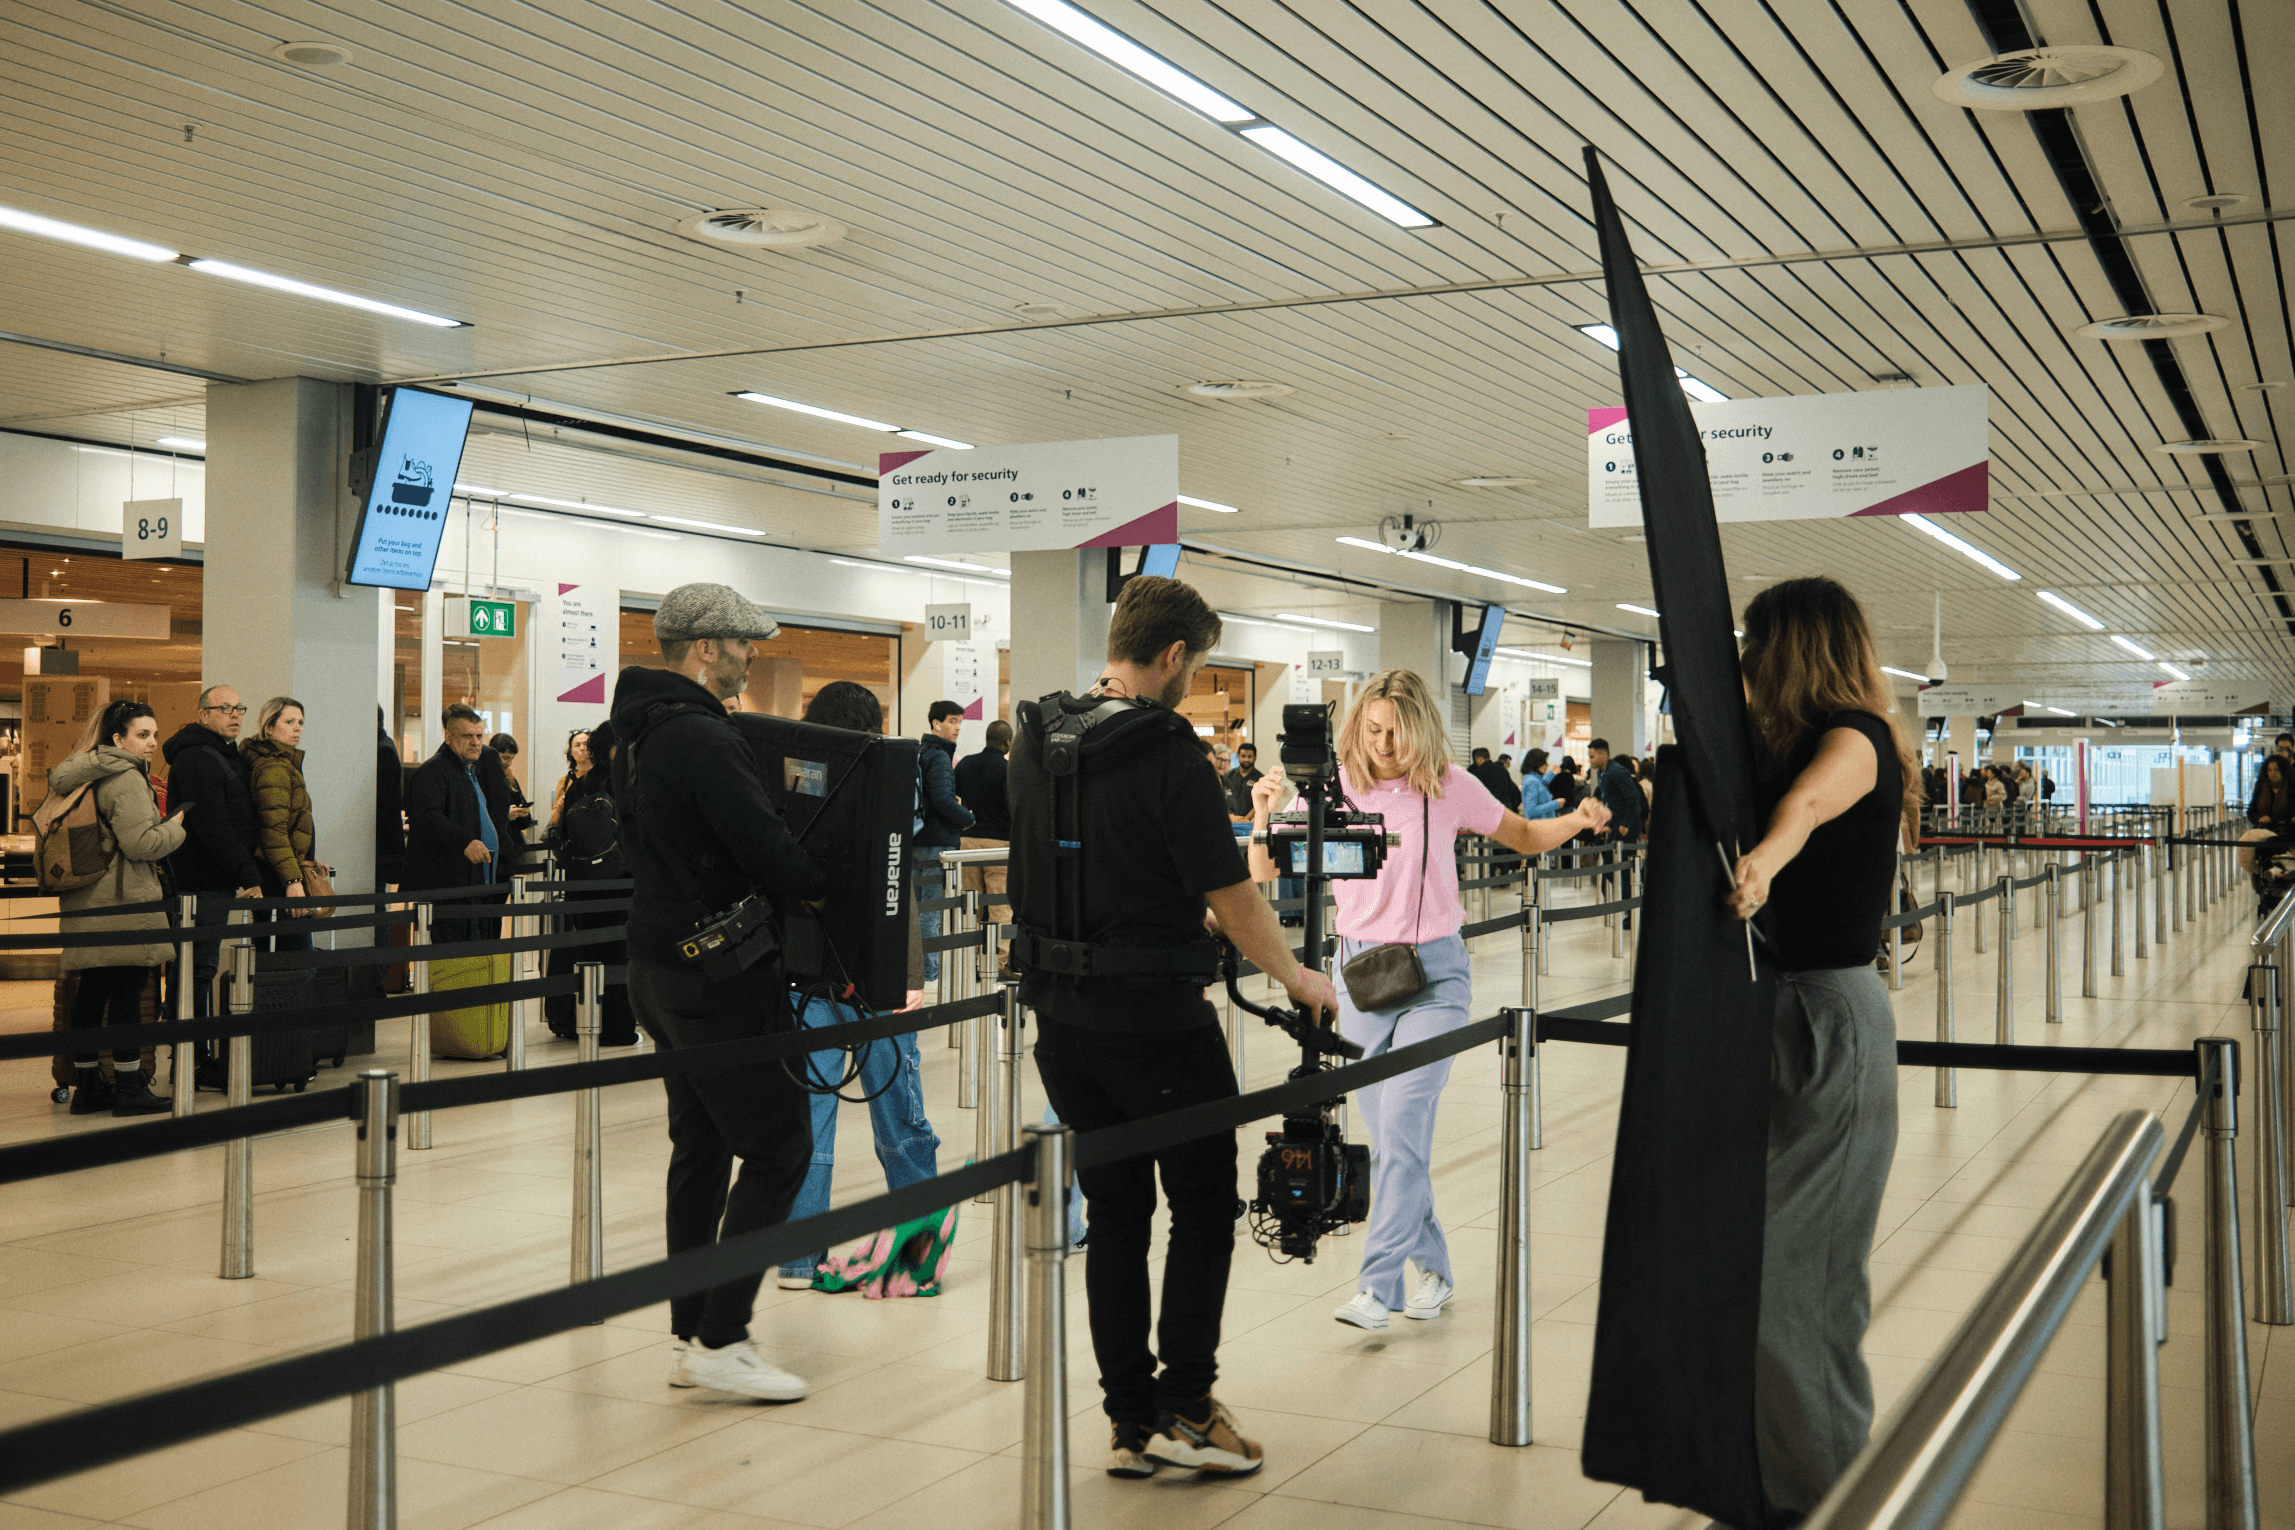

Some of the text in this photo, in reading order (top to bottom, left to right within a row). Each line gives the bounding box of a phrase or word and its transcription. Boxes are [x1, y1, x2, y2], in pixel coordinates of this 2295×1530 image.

[1606, 433, 1633, 444] Get
[1711, 425, 1773, 440] security
[892, 468, 1018, 485] Get ready for security
[138, 517, 168, 540] 8-9
[59, 609, 72, 626] 6
[930, 615, 966, 629] 10-11
[1311, 659, 1340, 670] 12-13
[1532, 684, 1556, 694] 14-15
[789, 764, 823, 779] amaran
[886, 832, 902, 916] amaran
